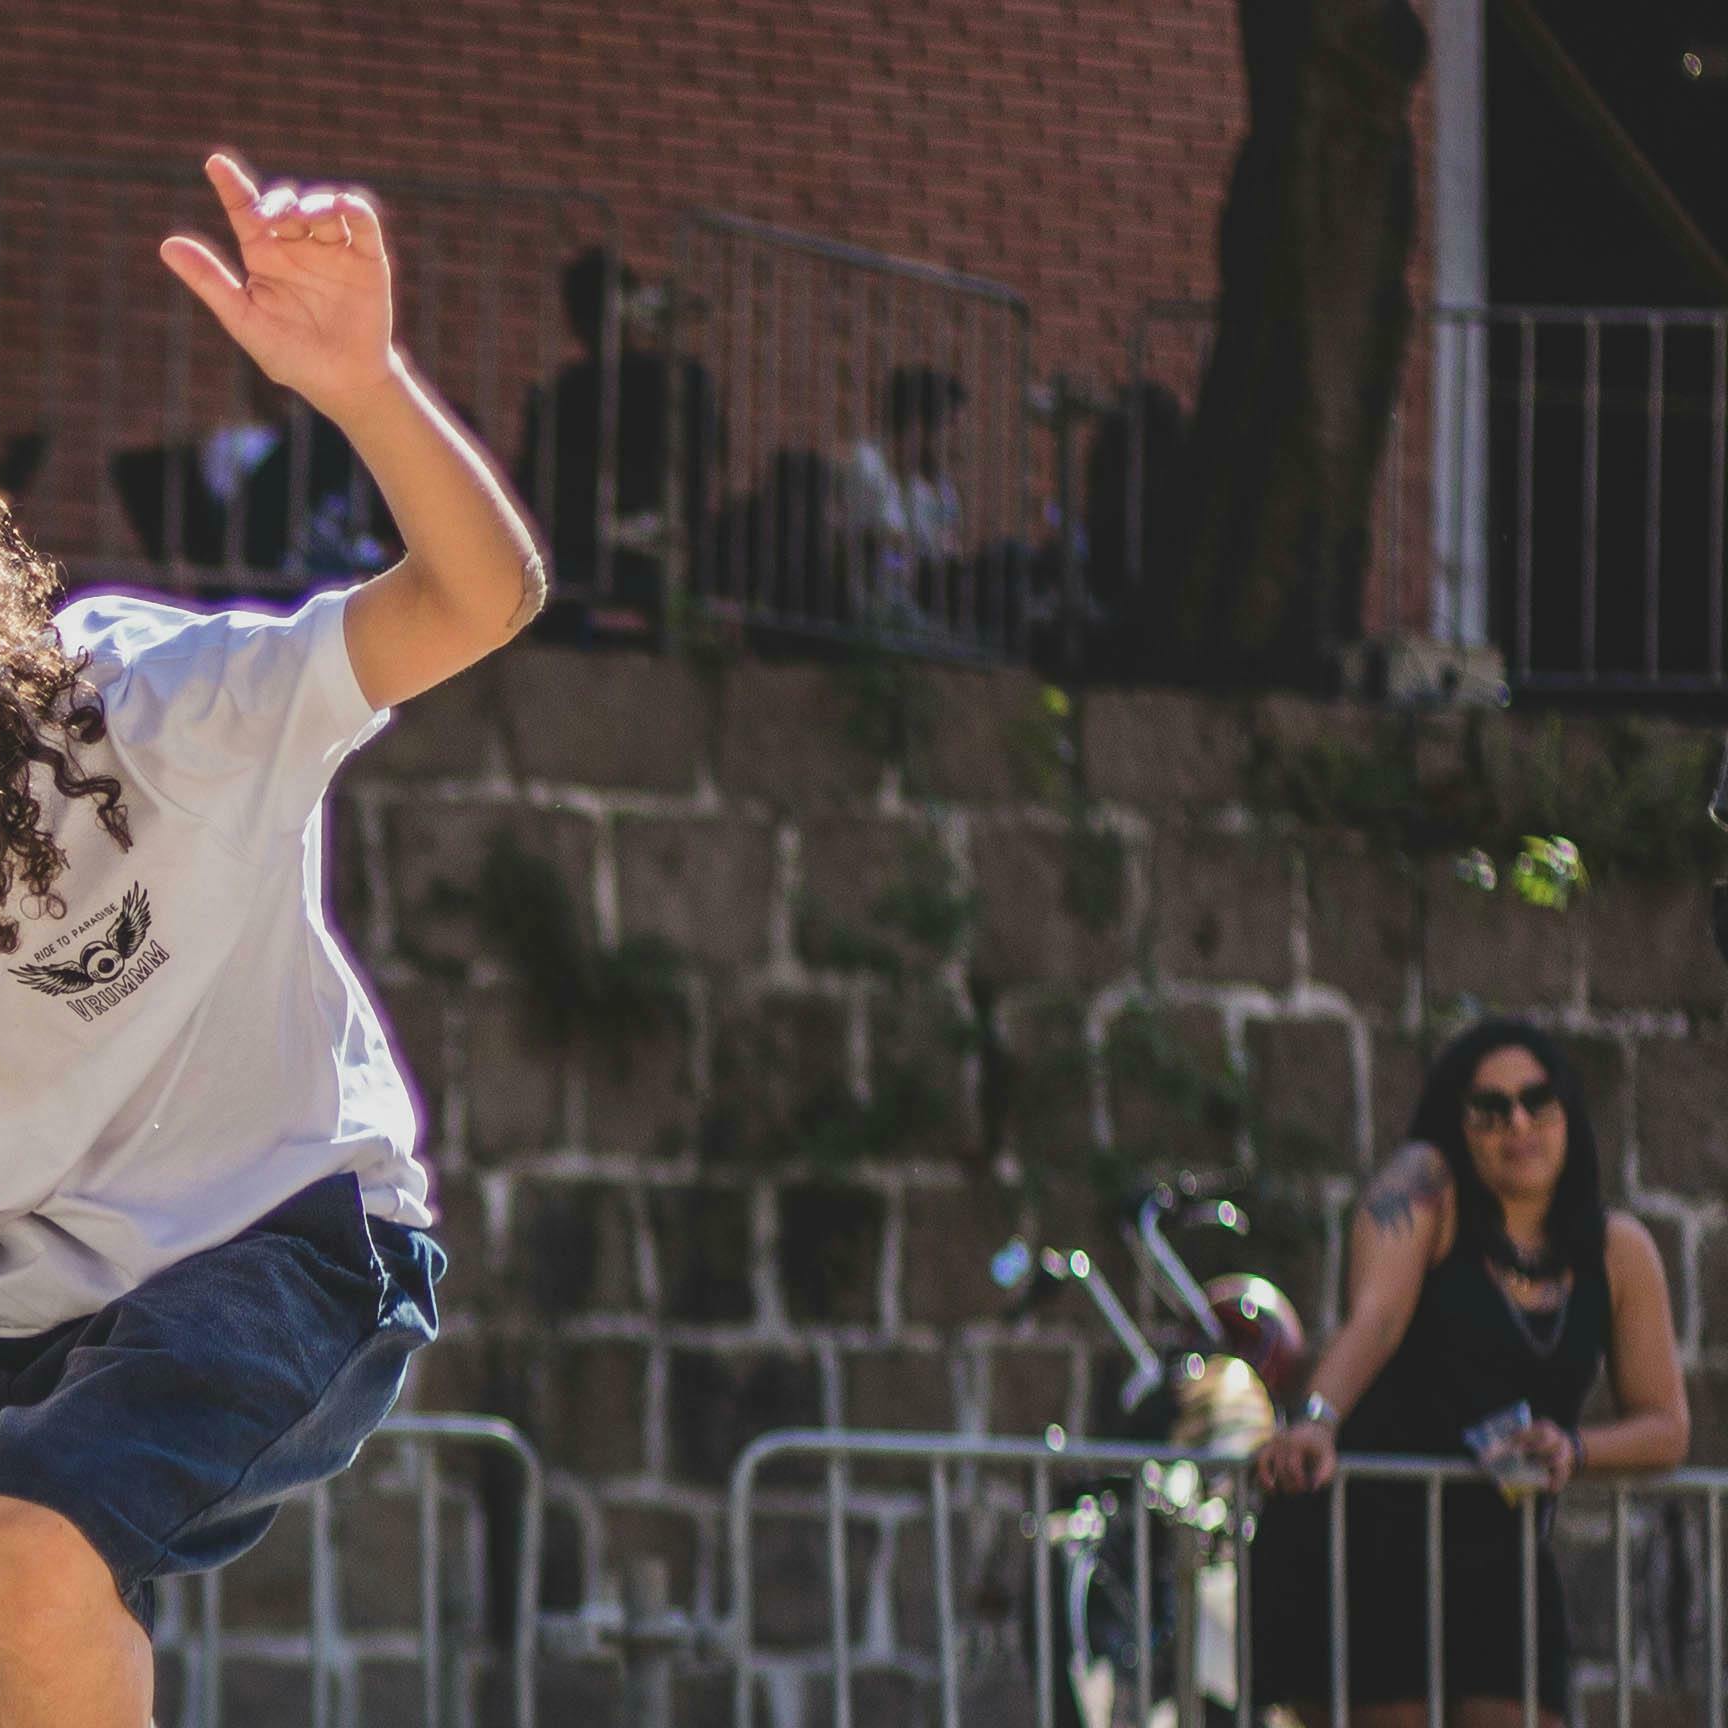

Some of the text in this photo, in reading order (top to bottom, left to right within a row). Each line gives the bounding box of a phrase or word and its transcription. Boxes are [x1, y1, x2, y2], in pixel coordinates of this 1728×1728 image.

[33, 902, 119, 963] RIDE TO PARADISE
[66, 939, 170, 1022] VRUMMM
